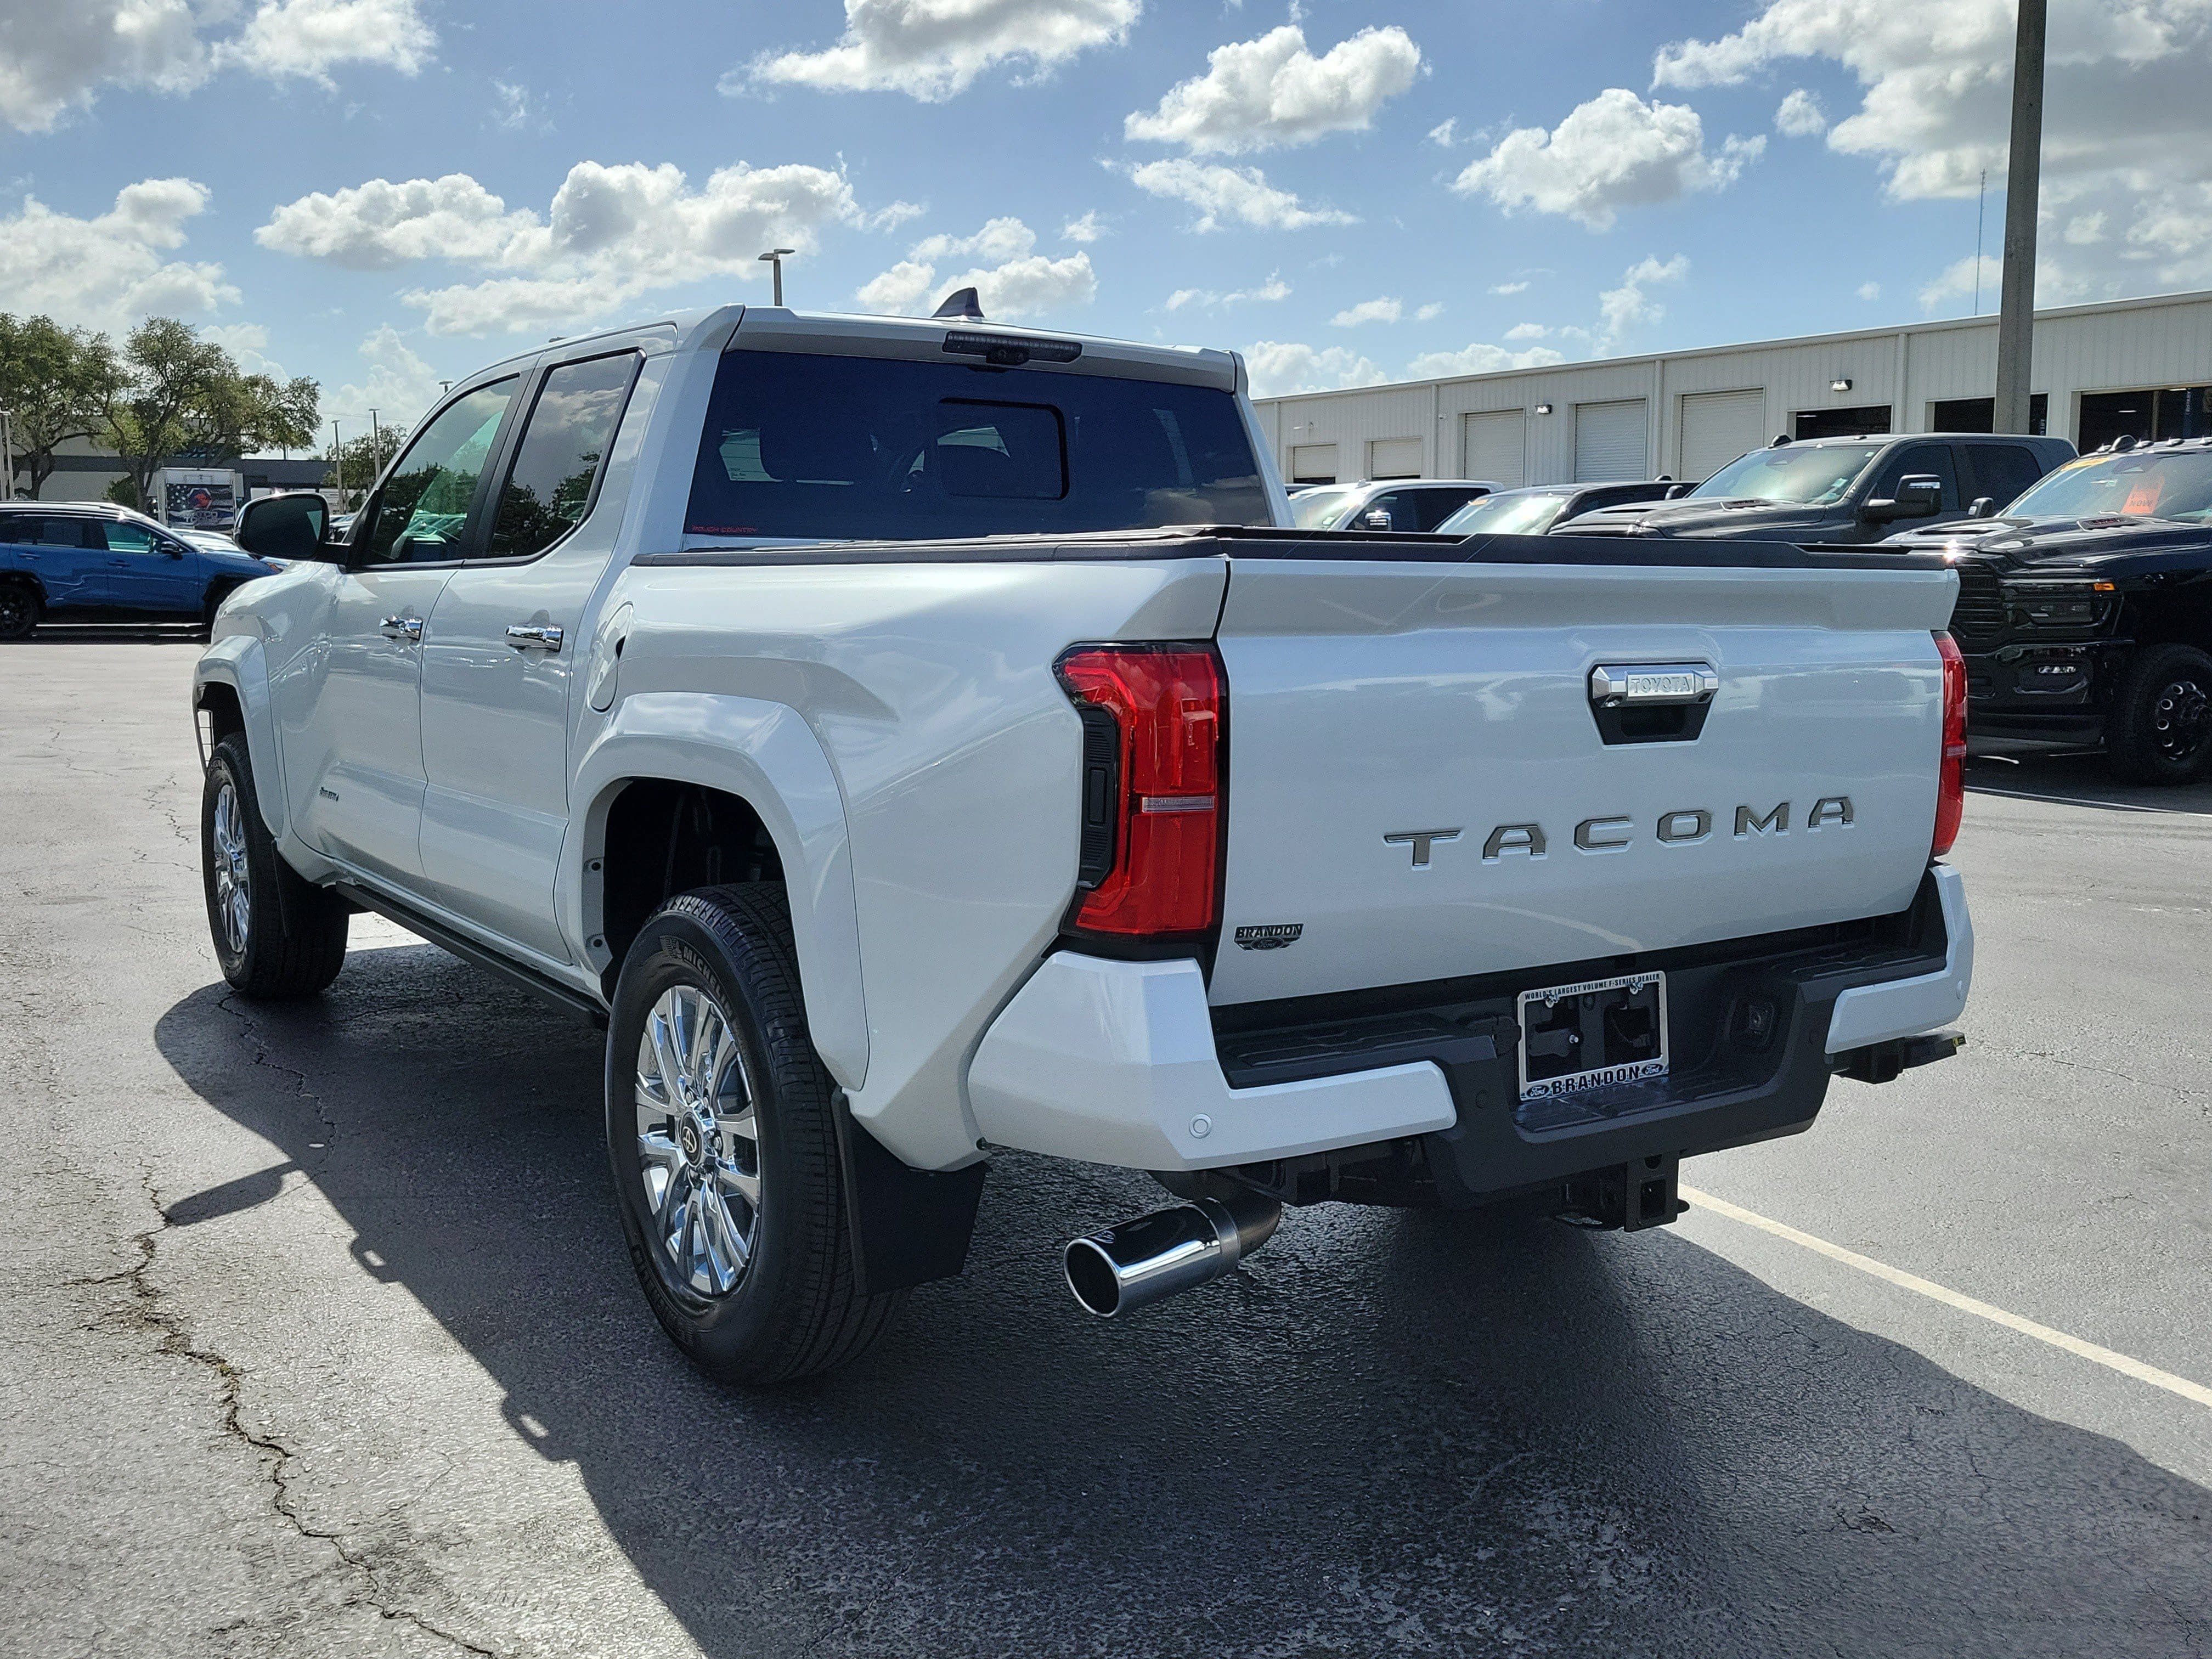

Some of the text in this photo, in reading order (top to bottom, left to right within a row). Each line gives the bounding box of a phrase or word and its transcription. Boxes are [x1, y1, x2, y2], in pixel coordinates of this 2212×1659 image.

[1631, 677, 1690, 693] TOYOTA
[1384, 796, 1855, 867] TACOMA
[1236, 924, 1304, 938] BRANDON
[683, 945, 733, 1019] MICHELIN
[1525, 973, 1660, 1000] WORLD'S LARGEST VOLUME F-SERIES DEALER
[1529, 1064, 1662, 1097] Ford BRANDON Ford
